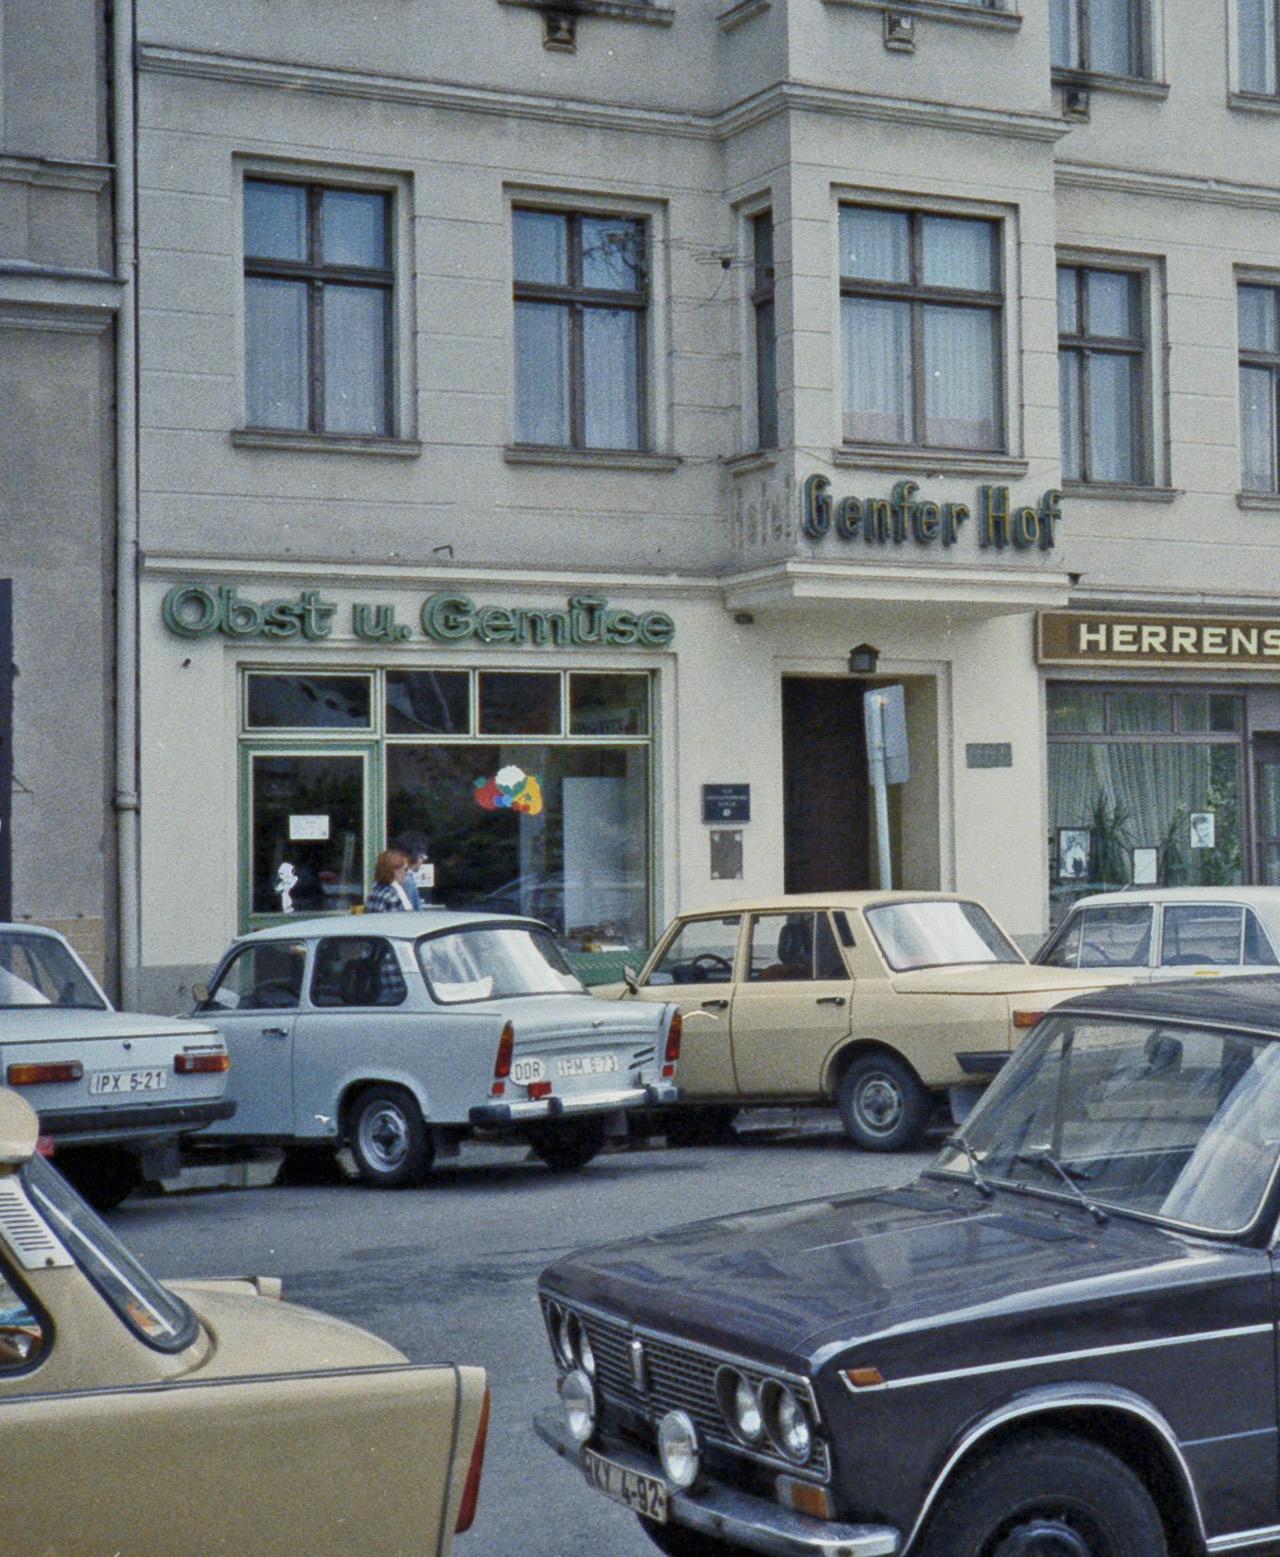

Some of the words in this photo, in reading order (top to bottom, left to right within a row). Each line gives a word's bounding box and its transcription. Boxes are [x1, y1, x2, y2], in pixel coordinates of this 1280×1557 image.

[804, 474, 970, 548] Genfer
[976, 486, 1063, 550] Hof
[162, 584, 337, 640] Obst
[352, 603, 412, 641] u.
[420, 590, 675, 645] Gemüse
[130, 1071, 163, 1091] 5-21
[514, 1061, 541, 1081] DDR
